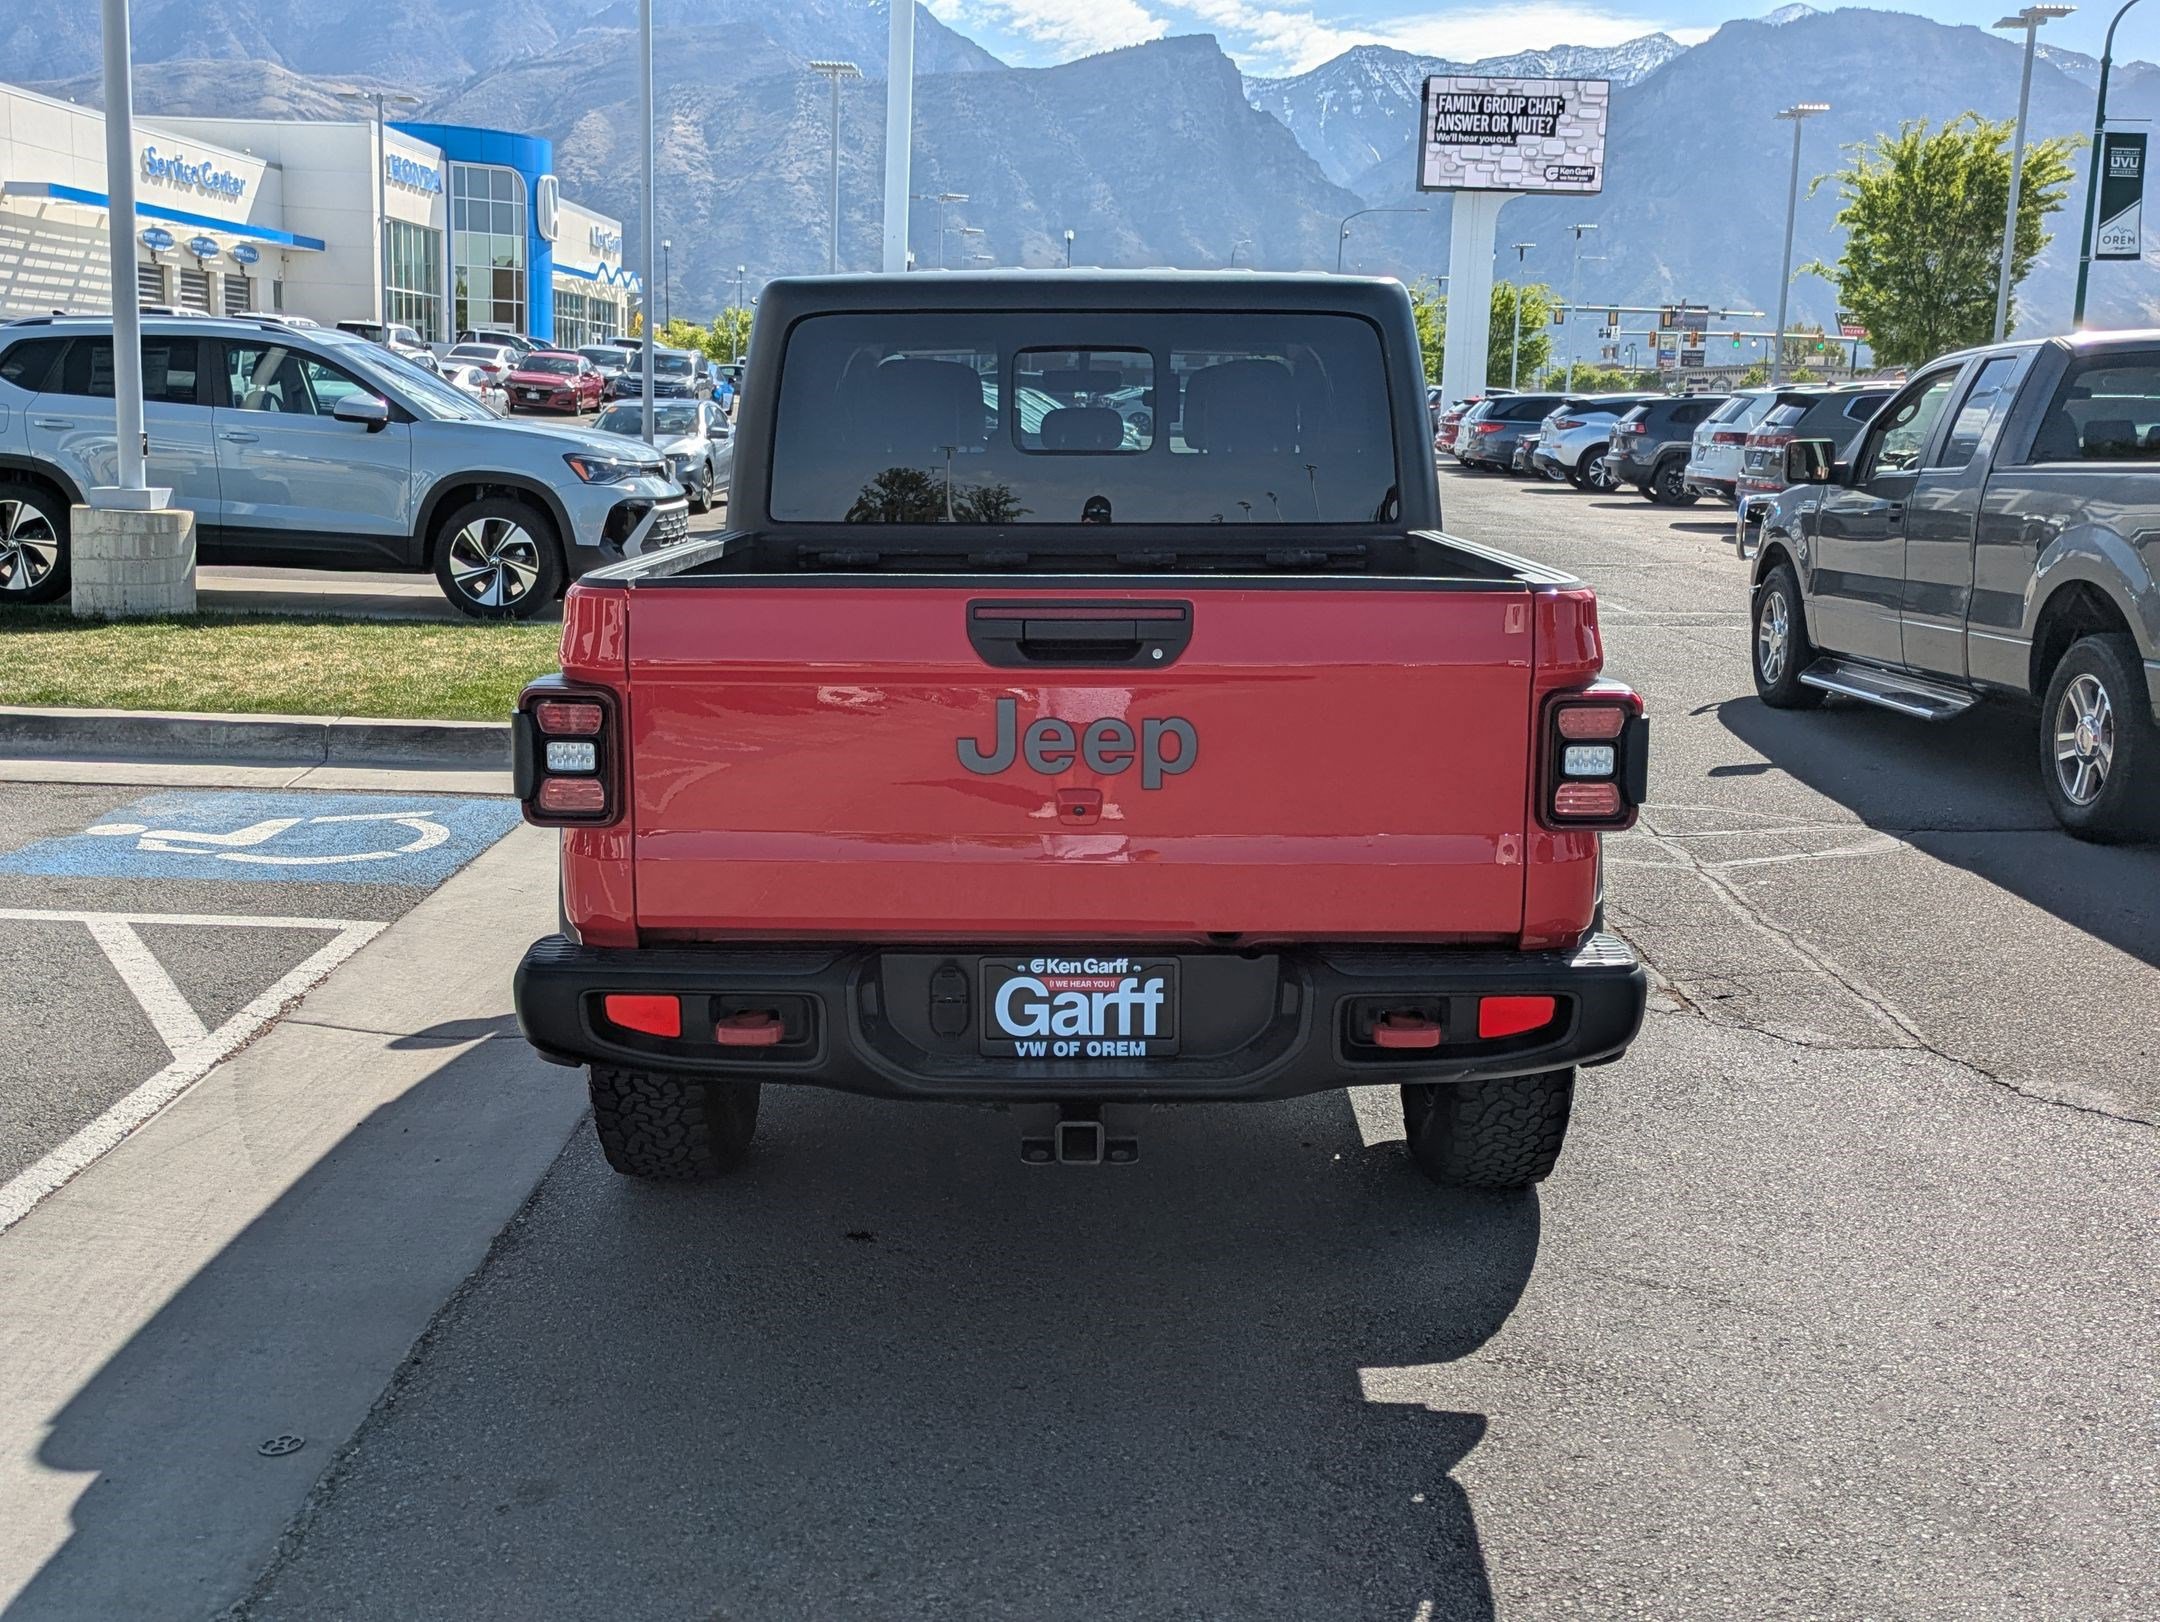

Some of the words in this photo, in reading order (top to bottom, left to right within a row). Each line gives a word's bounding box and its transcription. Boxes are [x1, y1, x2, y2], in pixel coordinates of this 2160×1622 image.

[1438, 95, 1481, 114] FAMILY
[1483, 96, 1526, 114] GROUP
[1527, 98, 1564, 115] CHAT:
[1436, 114, 1489, 132] ANSWER
[1490, 117, 1509, 133] OR
[1511, 117, 1554, 134] MUTE?
[1436, 133, 1457, 143] We'll
[1458, 133, 1478, 143] hear
[1478, 135, 1496, 145] you
[1495, 136, 1514, 144] out.
[2110, 156, 2139, 168] UVU
[145, 146, 200, 185] Service
[200, 161, 247, 196] Center
[387, 154, 443, 194] HONDA
[1559, 166, 1574, 175] Ken
[1574, 167, 1594, 176] Garff
[2102, 235, 2136, 245] OREM
[955, 697, 1199, 790] Jeep
[1046, 958, 1082, 974] Ken
[1083, 958, 1129, 974] Garff
[1055, 980, 1069, 988] WE
[1070, 980, 1092, 988] HEAR
[1093, 980, 1111, 988] YOU
[994, 976, 1164, 1037] Garff
[1014, 1041, 1048, 1057] VW
[1052, 1041, 1081, 1057] OF
[1086, 1041, 1147, 1057] OREM
